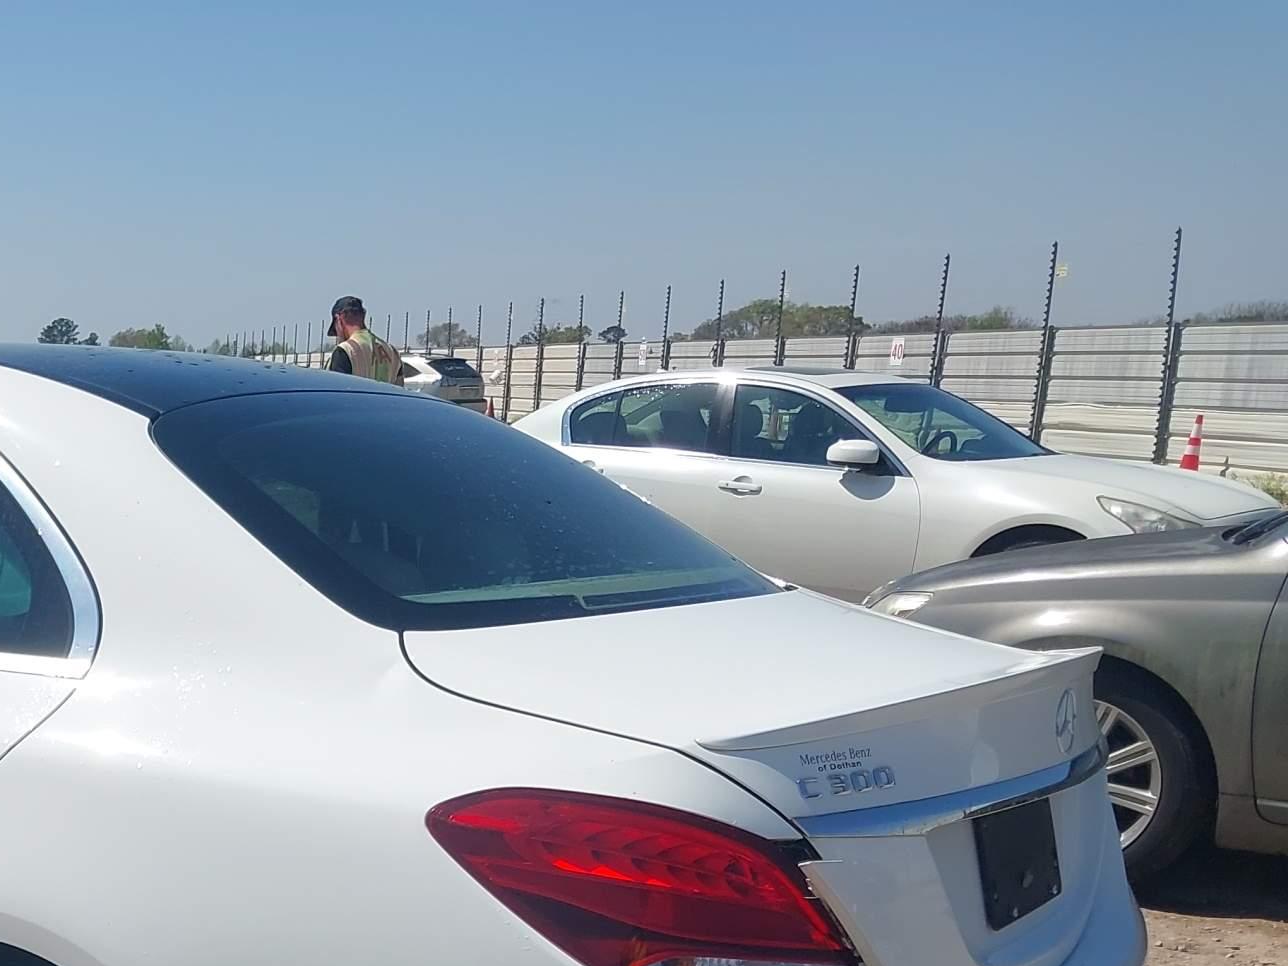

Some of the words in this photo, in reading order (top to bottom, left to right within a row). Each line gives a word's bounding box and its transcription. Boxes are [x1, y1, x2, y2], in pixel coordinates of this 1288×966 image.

[892, 344, 903, 360] 40
[799, 750, 847, 767] Mercedes
[848, 747, 872, 760] Benz
[817, 763, 827, 772] of
[830, 760, 862, 771] Dothan
[795, 776, 823, 799] C
[828, 767, 896, 795] 300
